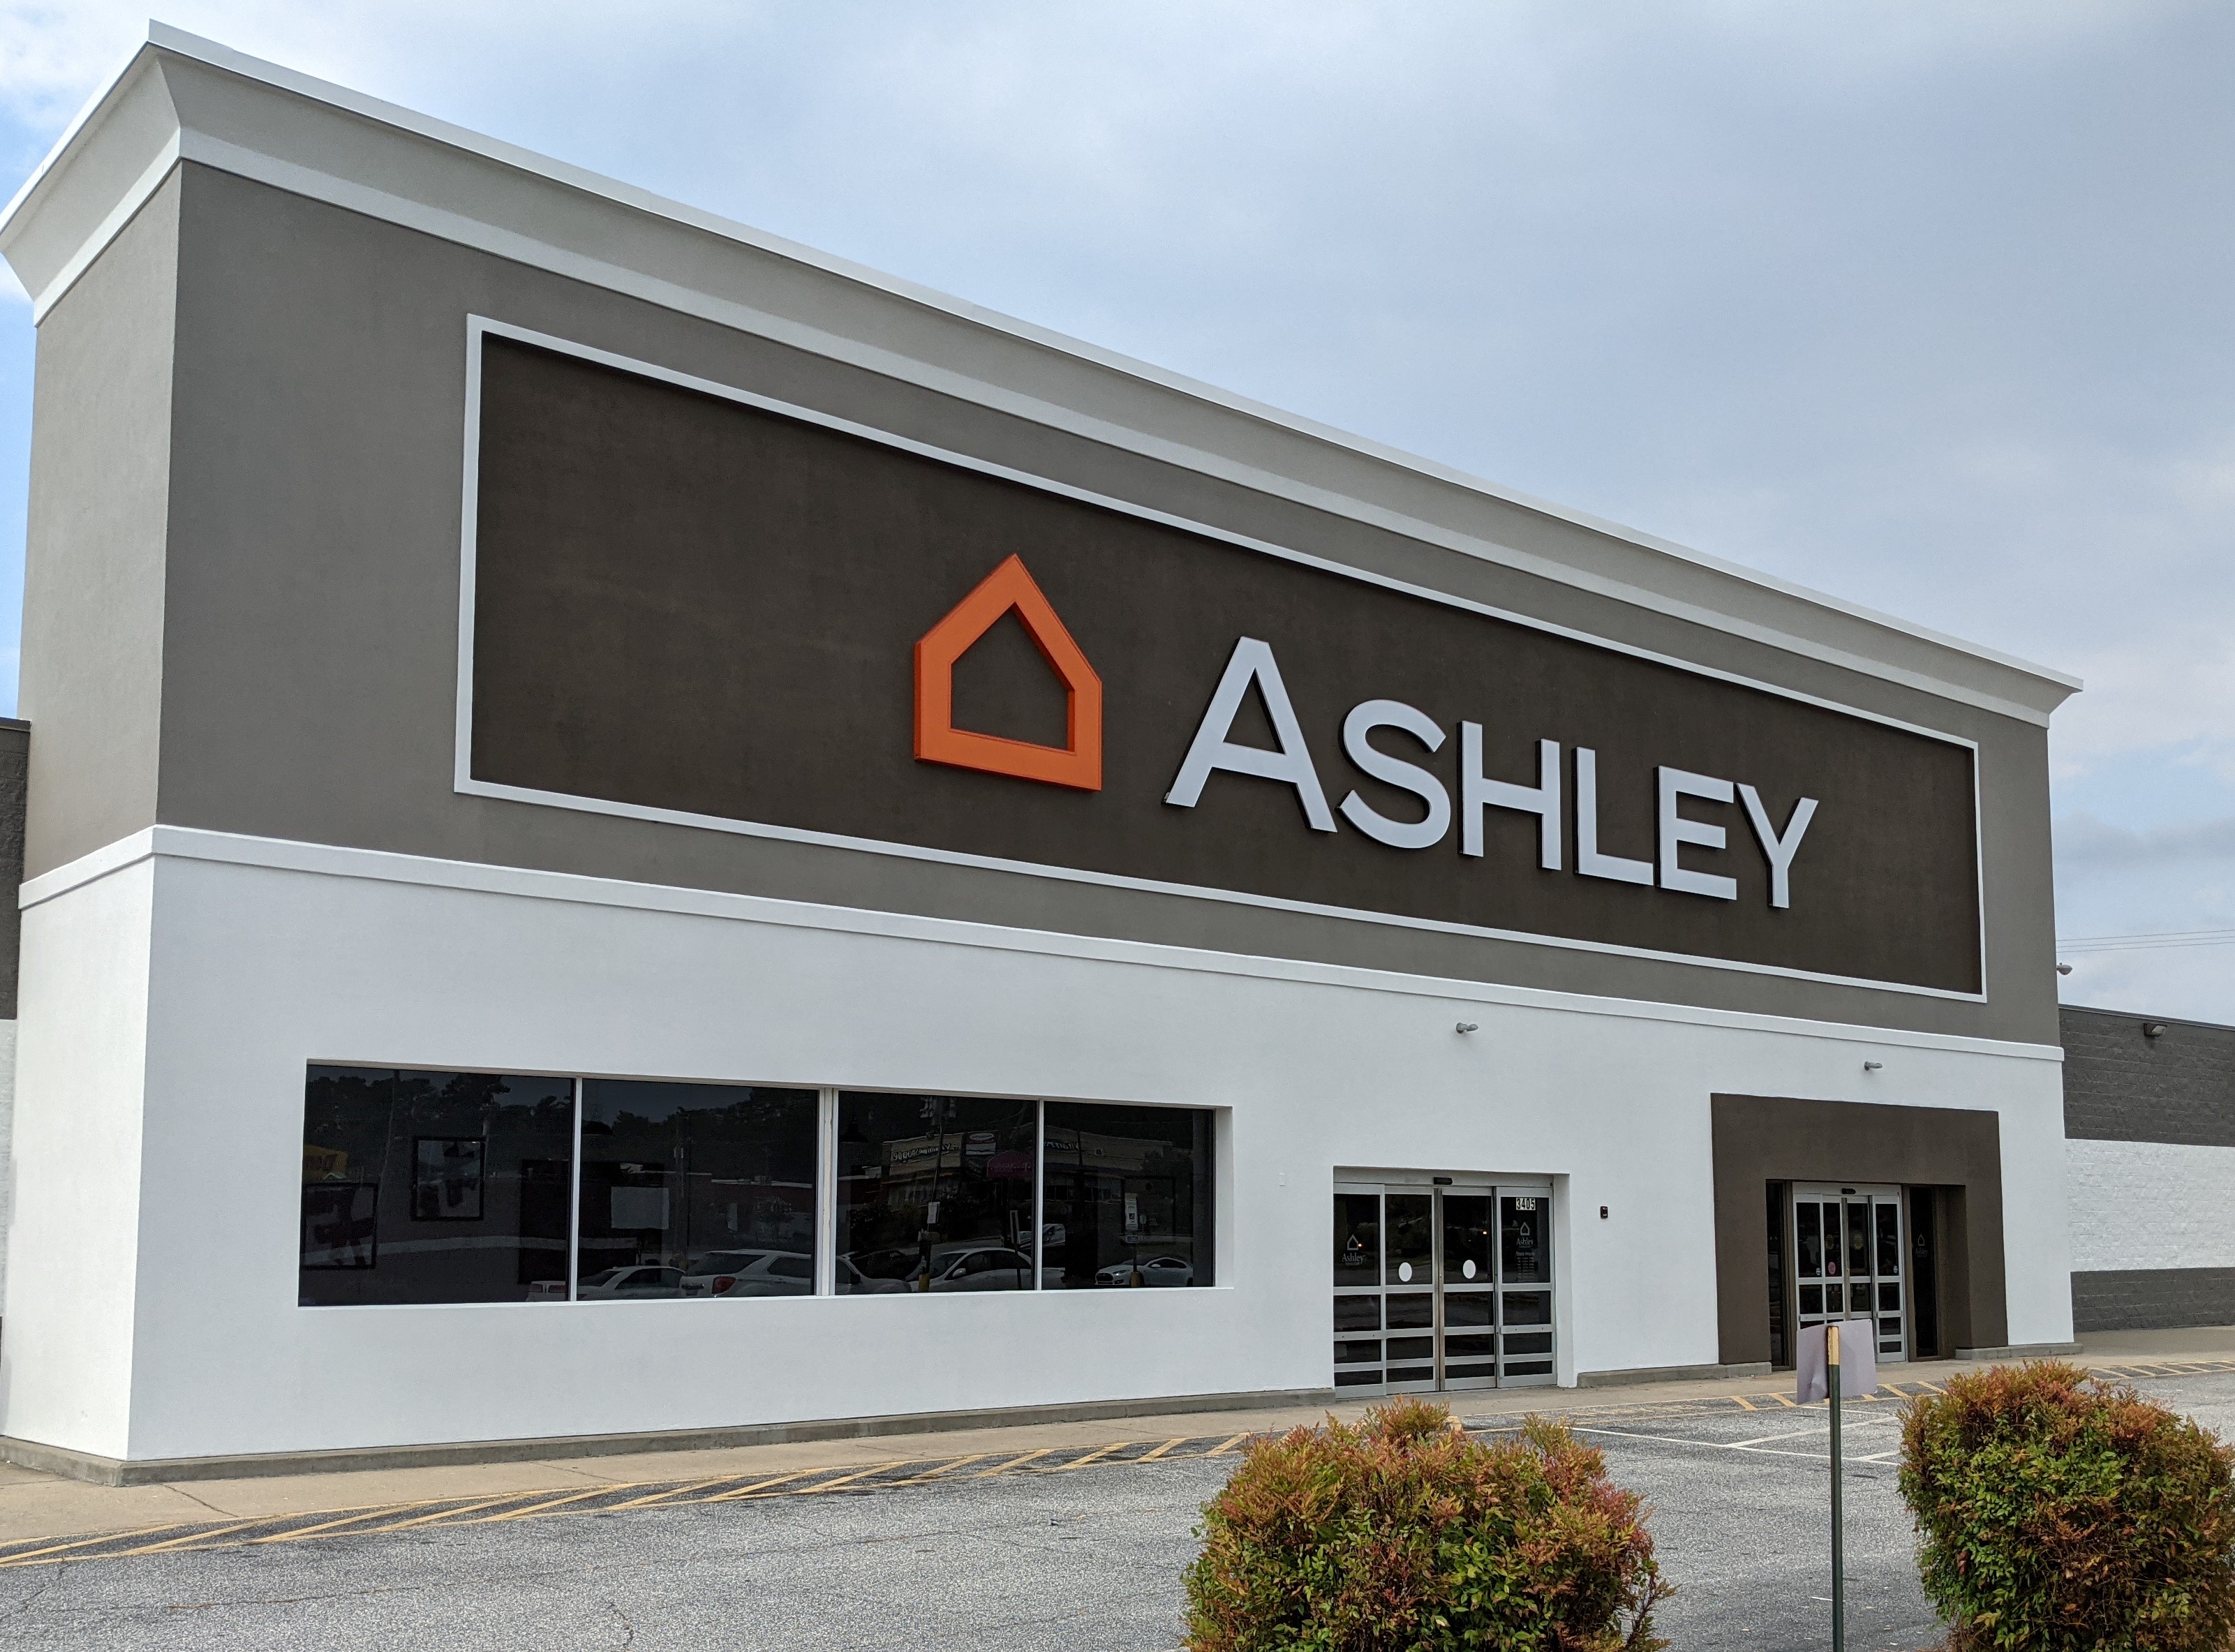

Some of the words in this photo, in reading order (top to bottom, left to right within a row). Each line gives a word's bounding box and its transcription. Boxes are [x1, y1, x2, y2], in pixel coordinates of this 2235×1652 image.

[1164, 636, 1819, 909] ASHLEY
[1516, 1198, 1536, 1210] 3405
[1342, 1252, 1366, 1264] Ashley
